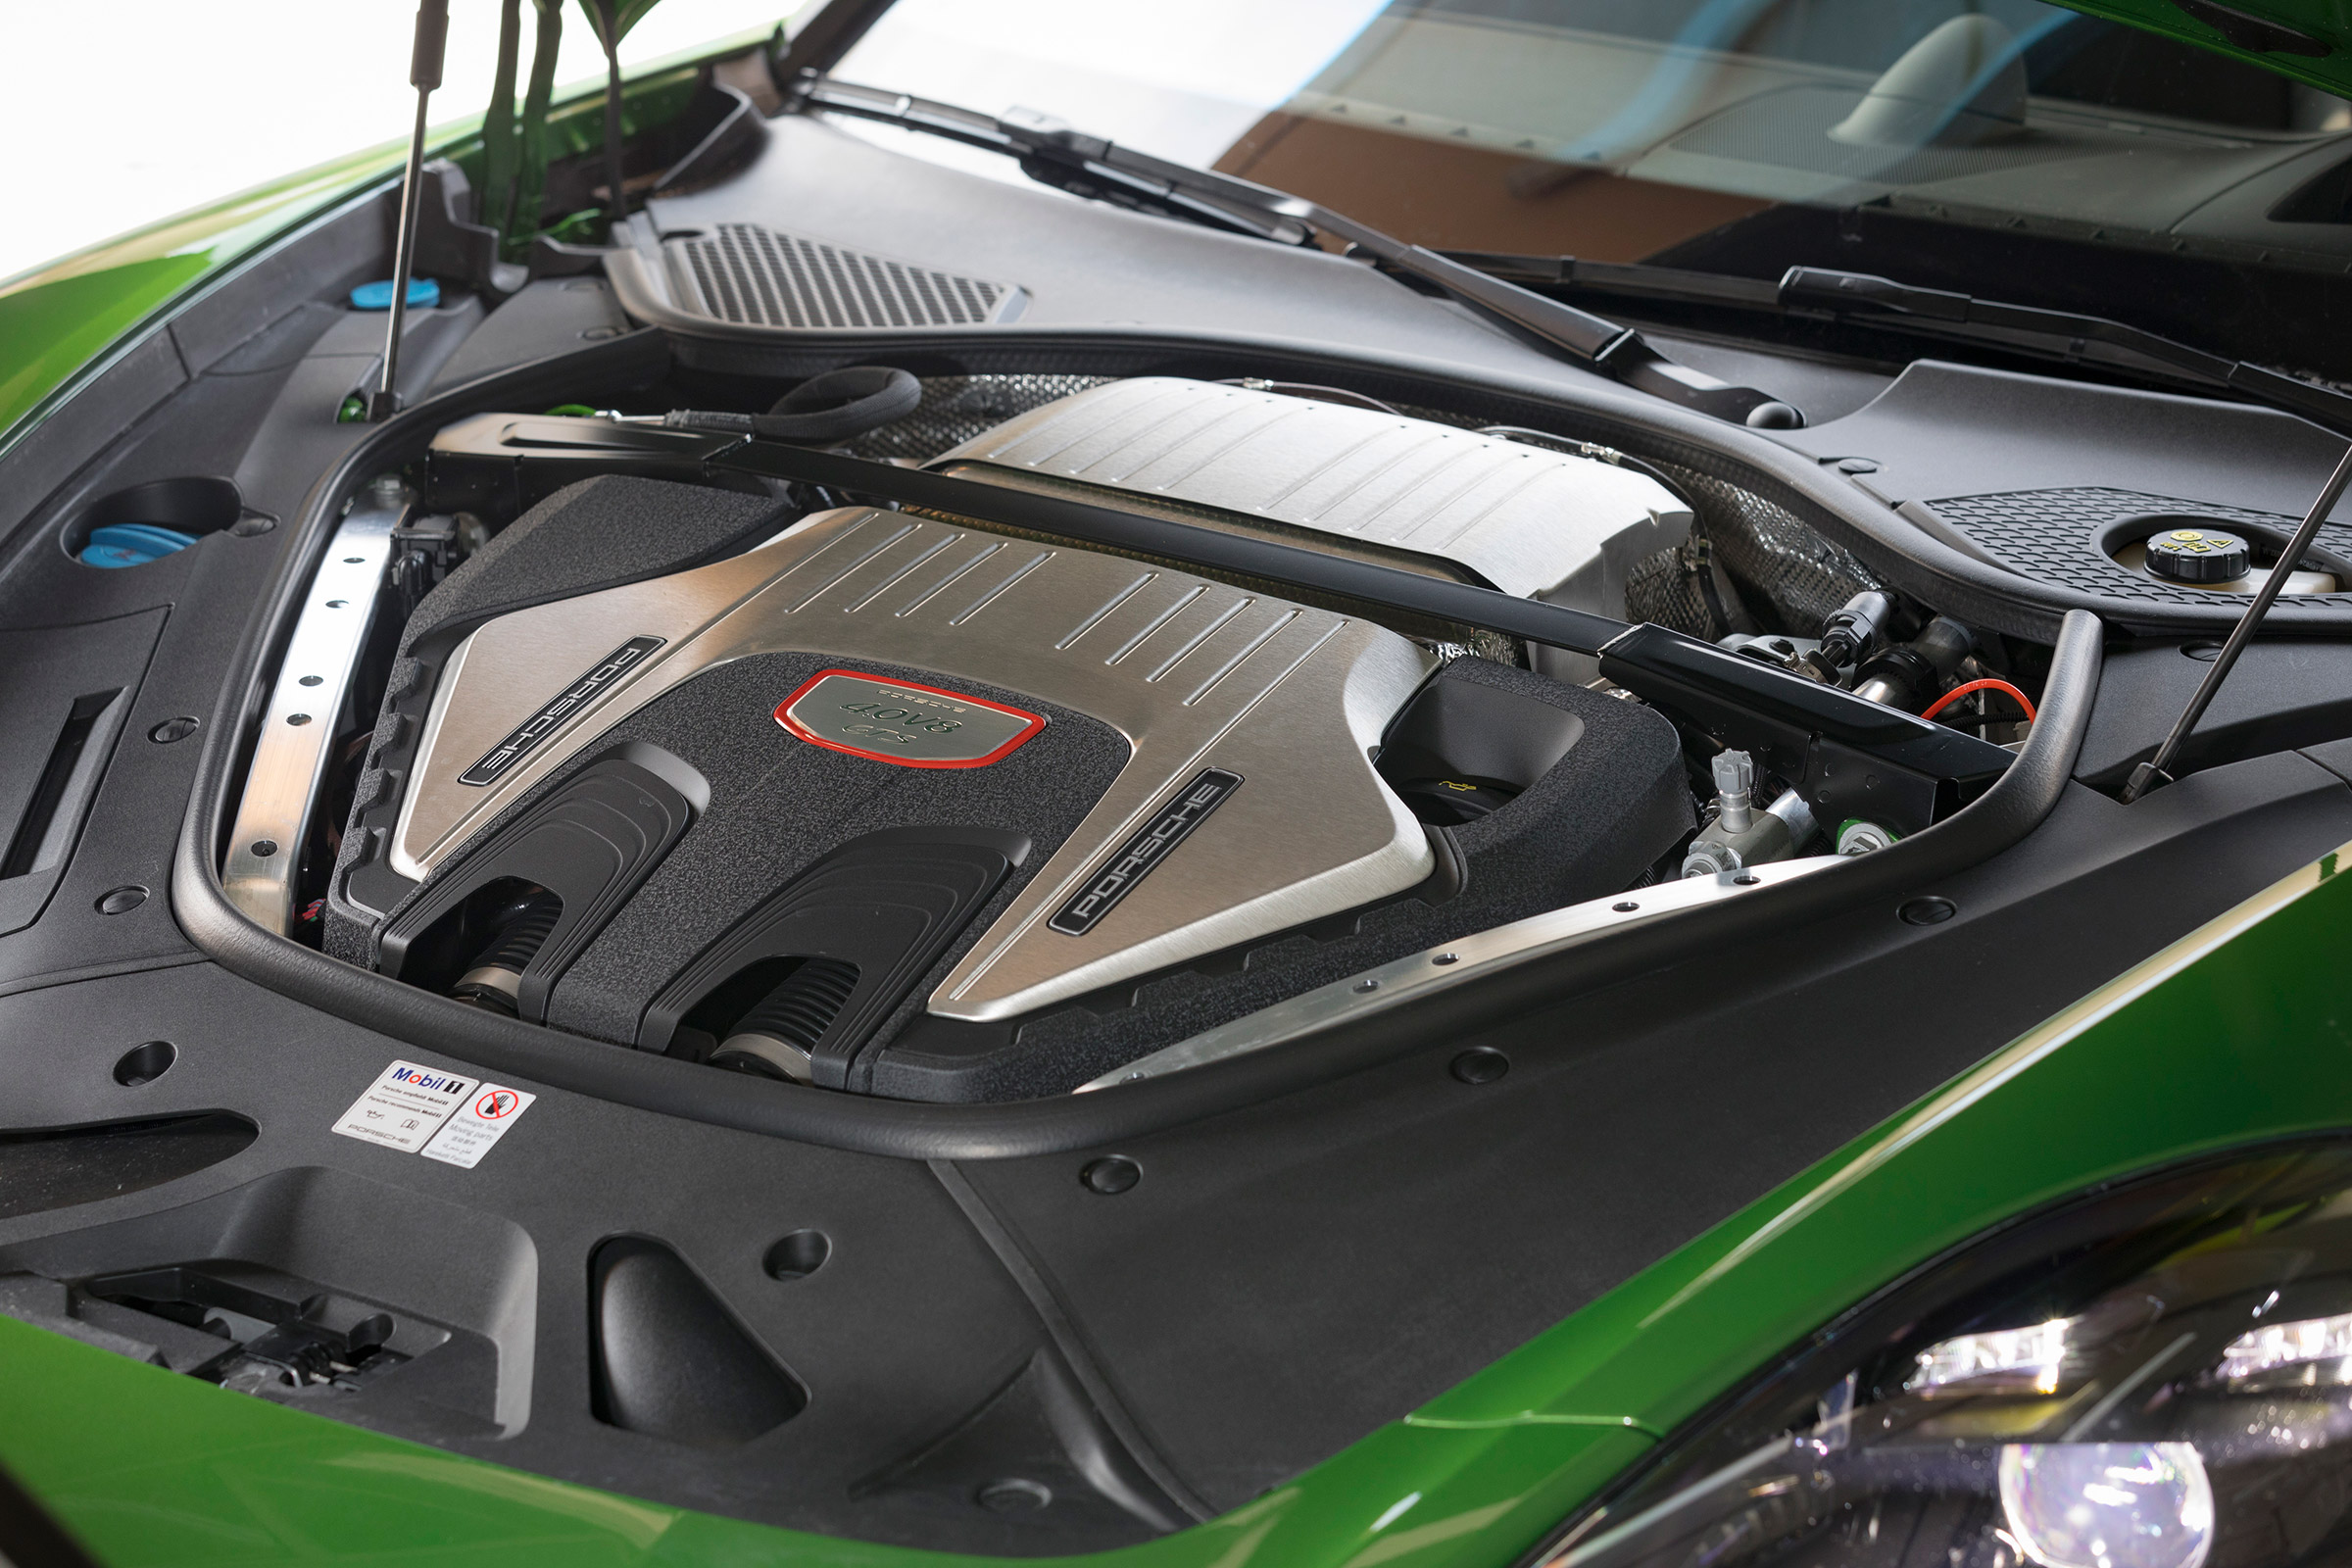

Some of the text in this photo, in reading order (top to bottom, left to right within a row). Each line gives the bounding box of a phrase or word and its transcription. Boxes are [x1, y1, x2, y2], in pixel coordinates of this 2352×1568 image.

[482, 648, 641, 769] PORSCHE
[877, 689, 966, 713] PORSCHE
[841, 723, 917, 745] GTS
[1072, 783, 1222, 919] PORSCHE
[392, 1067, 446, 1091] Mobil
[348, 1123, 411, 1145] PORSCHE
[449, 1124, 474, 1137] Moving
[473, 1131, 493, 1142] parts
